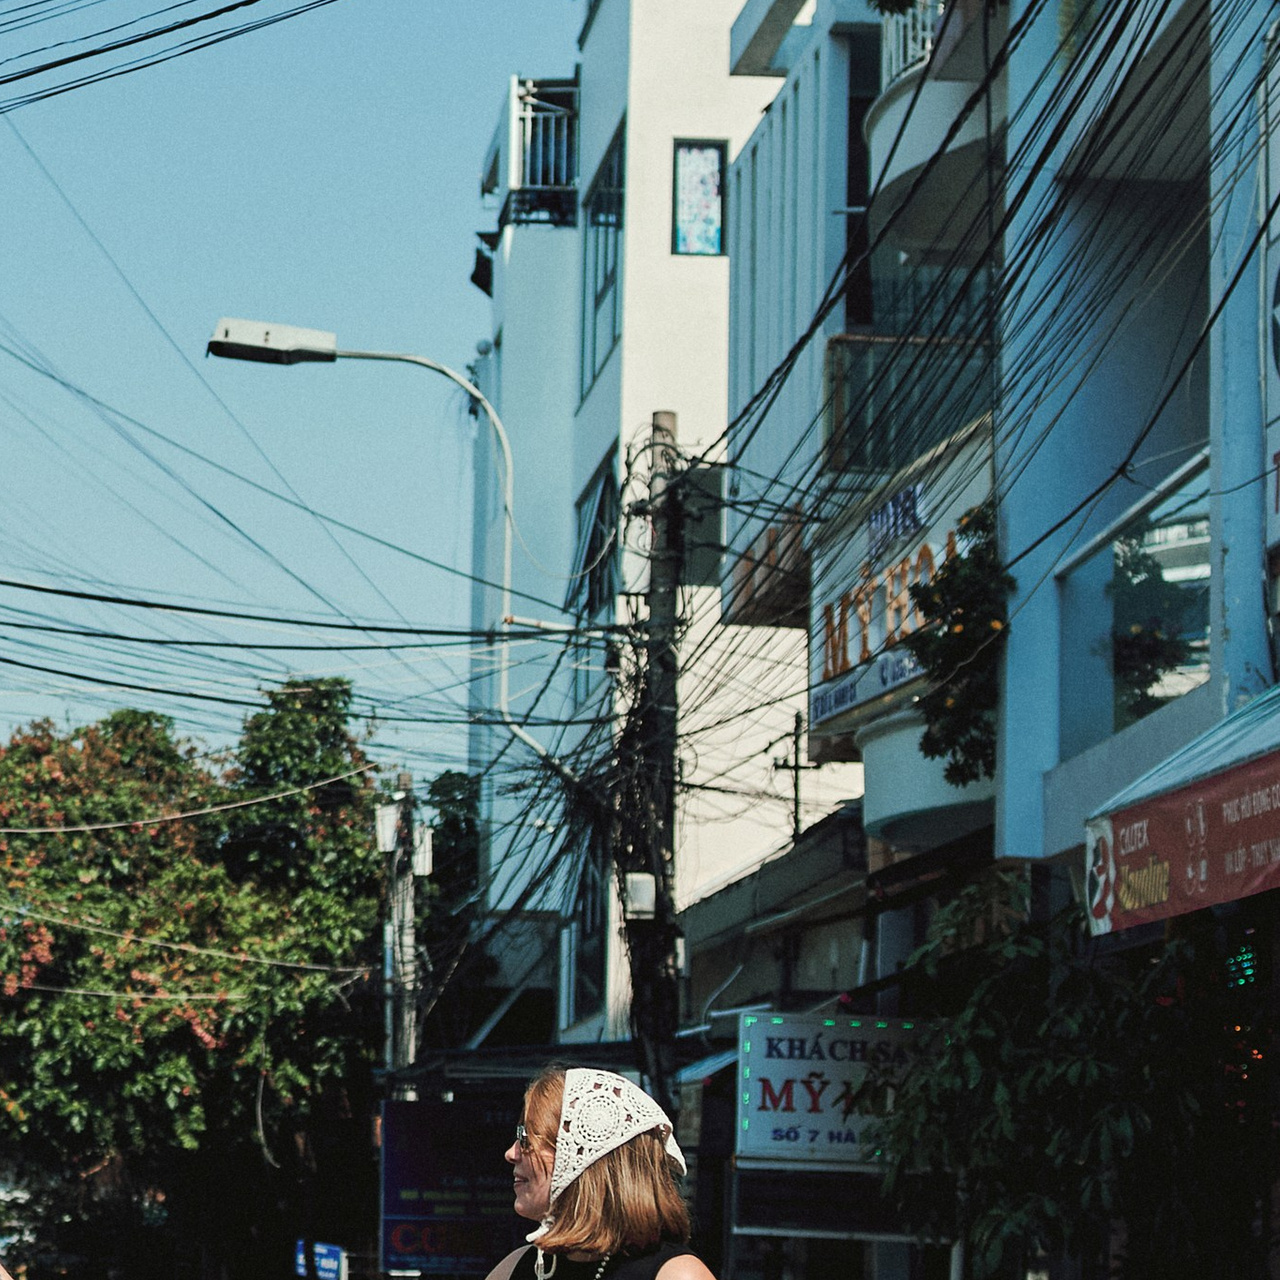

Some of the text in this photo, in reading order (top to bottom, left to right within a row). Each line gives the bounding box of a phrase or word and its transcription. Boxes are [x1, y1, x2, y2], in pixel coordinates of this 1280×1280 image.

[765, 1032, 868, 1062] KHÁCH
[756, 1071, 830, 1114] MỸ
[772, 1124, 801, 1142] SỐ
[808, 1129, 820, 1143] 7
